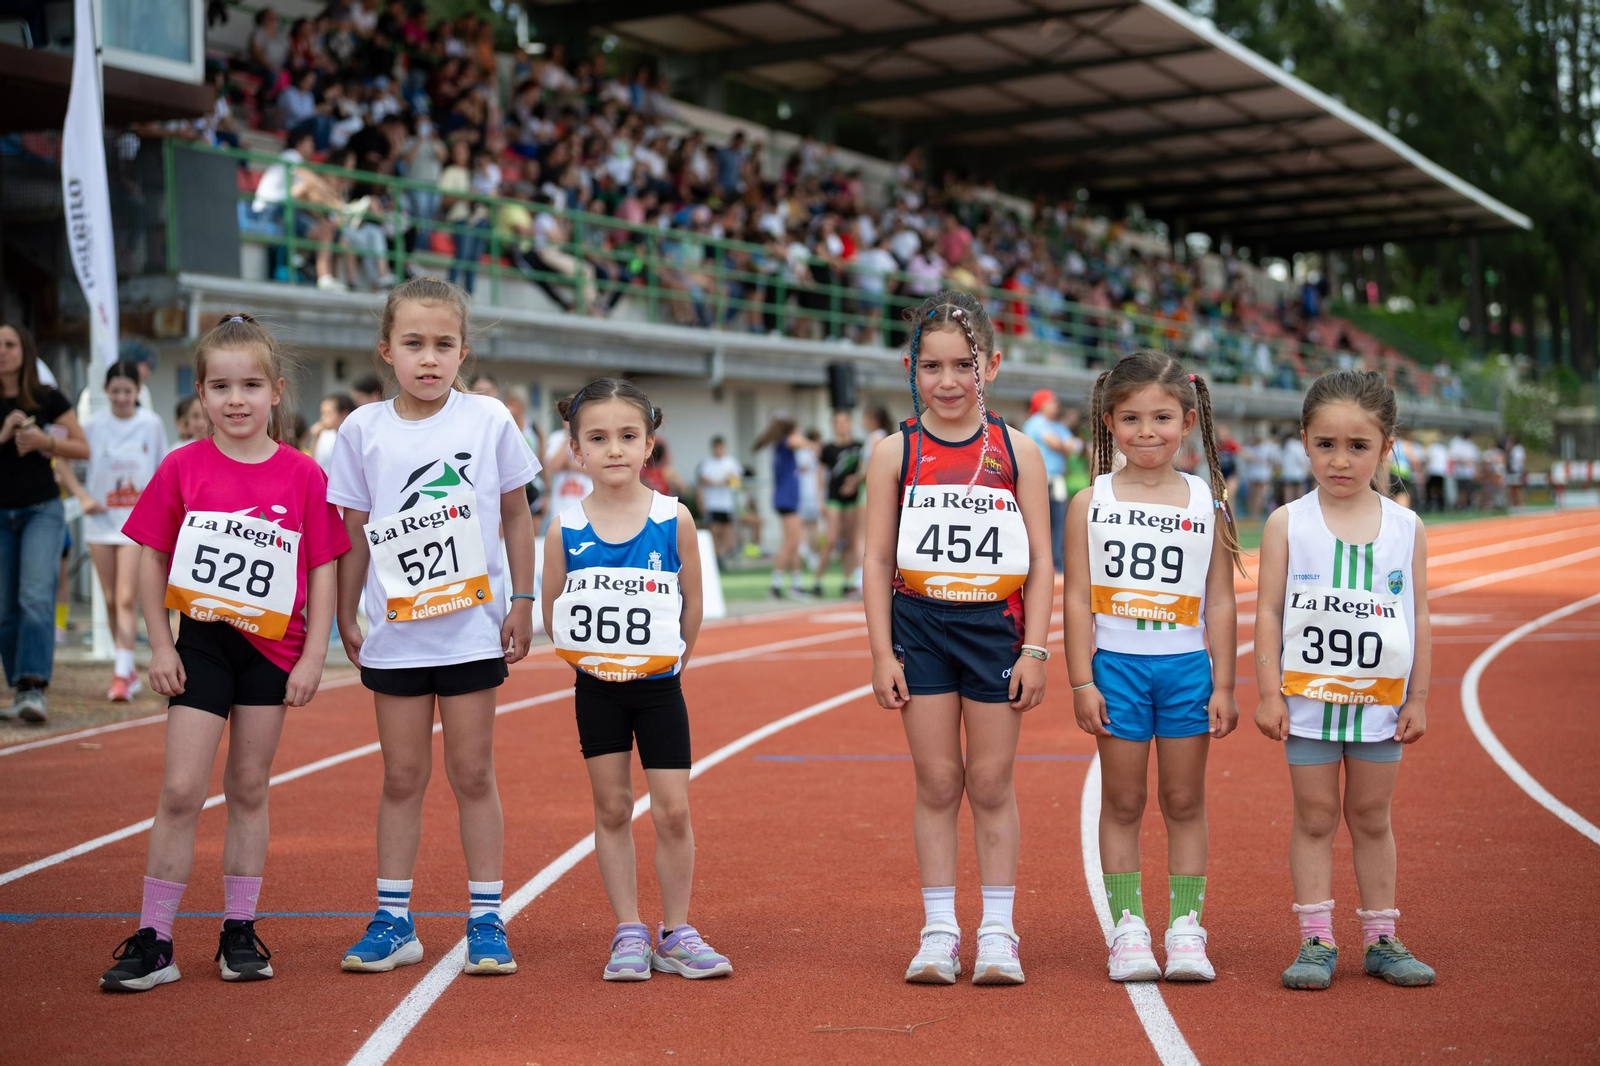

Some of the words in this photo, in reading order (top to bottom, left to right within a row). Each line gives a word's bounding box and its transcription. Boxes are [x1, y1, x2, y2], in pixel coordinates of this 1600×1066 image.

[906, 492, 936, 508] La
[187, 516, 218, 532] La
[1090, 507, 1121, 525] La
[368, 527, 399, 546] La
[916, 524, 1003, 564] 454
[397, 536, 459, 586] 521
[1103, 540, 1184, 584] 389
[191, 544, 275, 598] 528
[565, 577, 587, 594] La
[925, 586, 998, 602] telemiño
[411, 595, 473, 620] telemiño
[1291, 593, 1317, 611] La
[1111, 602, 1177, 622] telemiño
[570, 604, 651, 646] 368
[1302, 626, 1383, 669] 390
[581, 666, 648, 682] elemiño
[1302, 686, 1375, 705] telemiño
